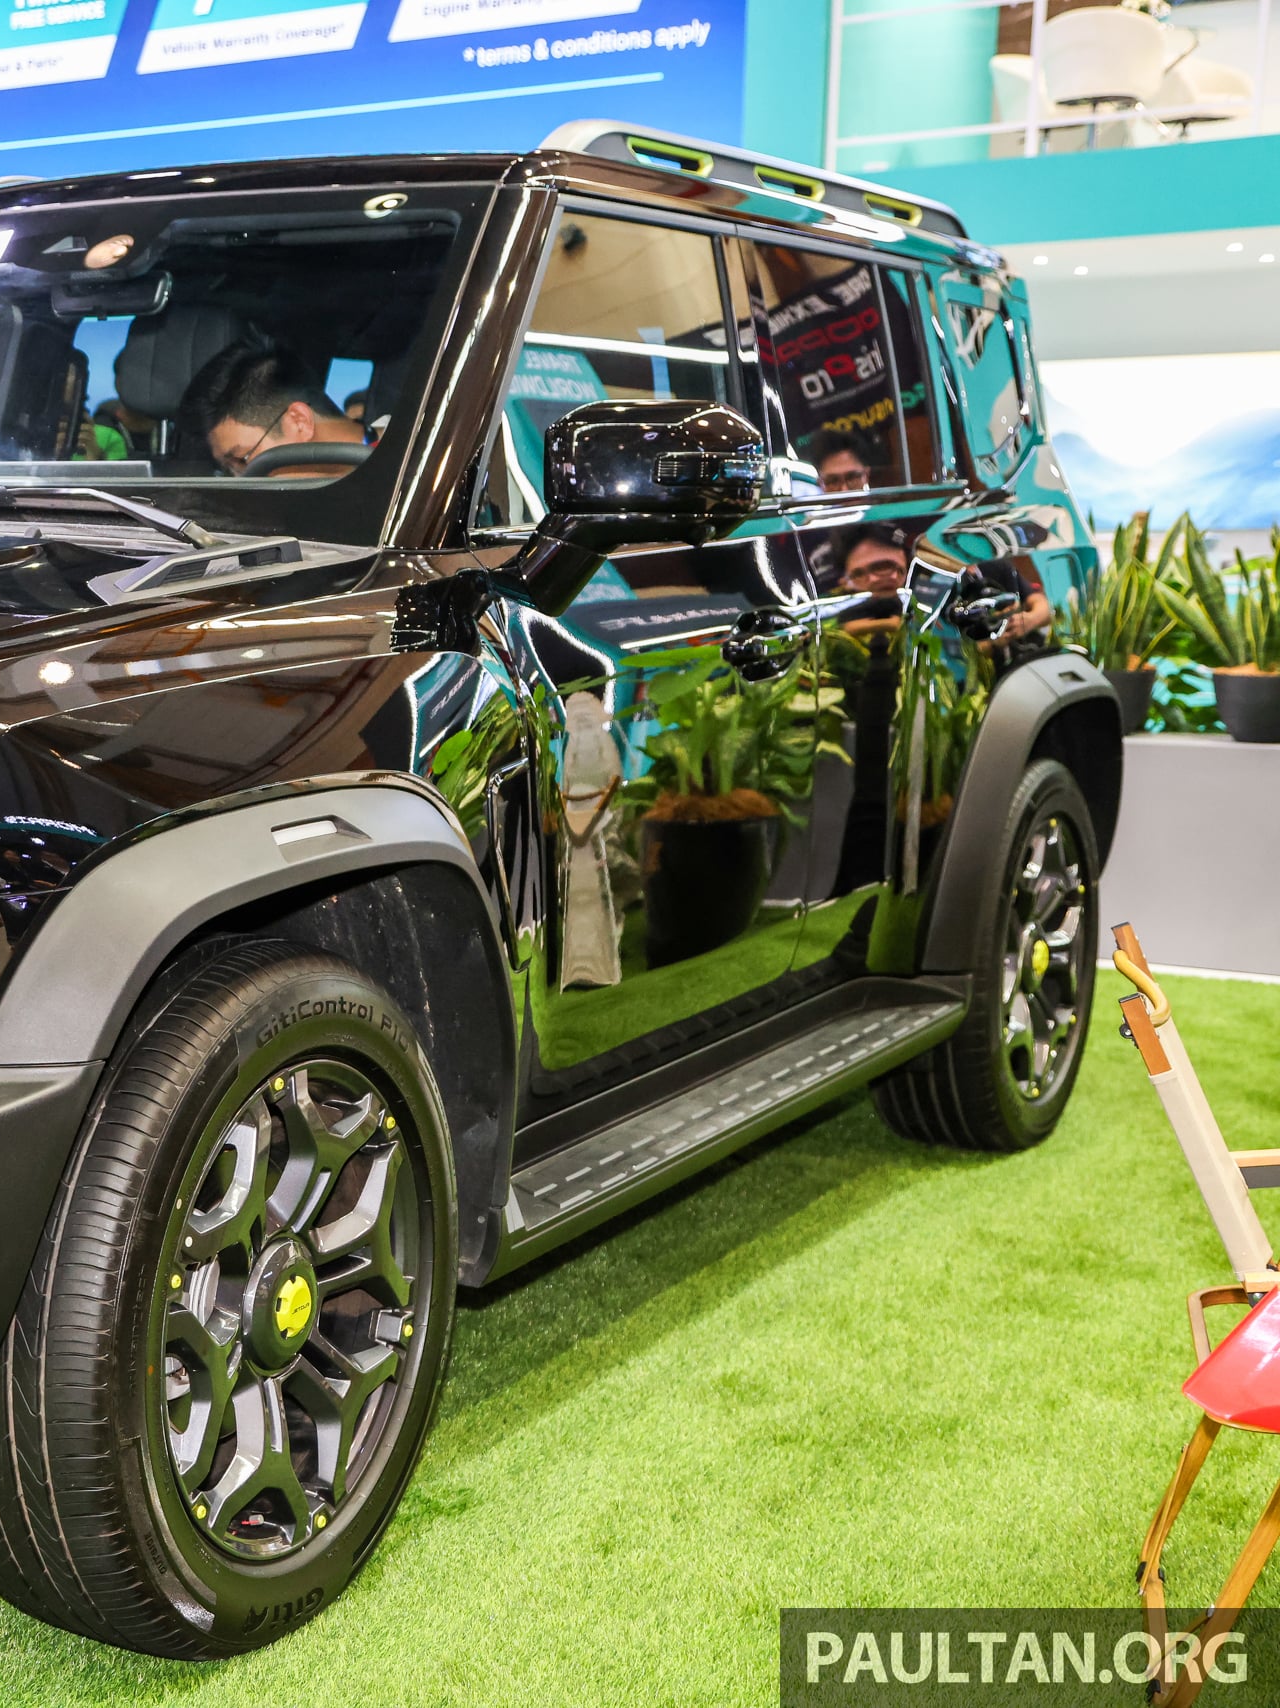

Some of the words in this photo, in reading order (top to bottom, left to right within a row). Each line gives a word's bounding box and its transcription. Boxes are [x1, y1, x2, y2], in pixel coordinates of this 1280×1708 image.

[534, 38, 549, 61] &
[551, 29, 652, 59] conditions
[654, 18, 711, 51] apply
[256, 996, 374, 1048] GitiControl
